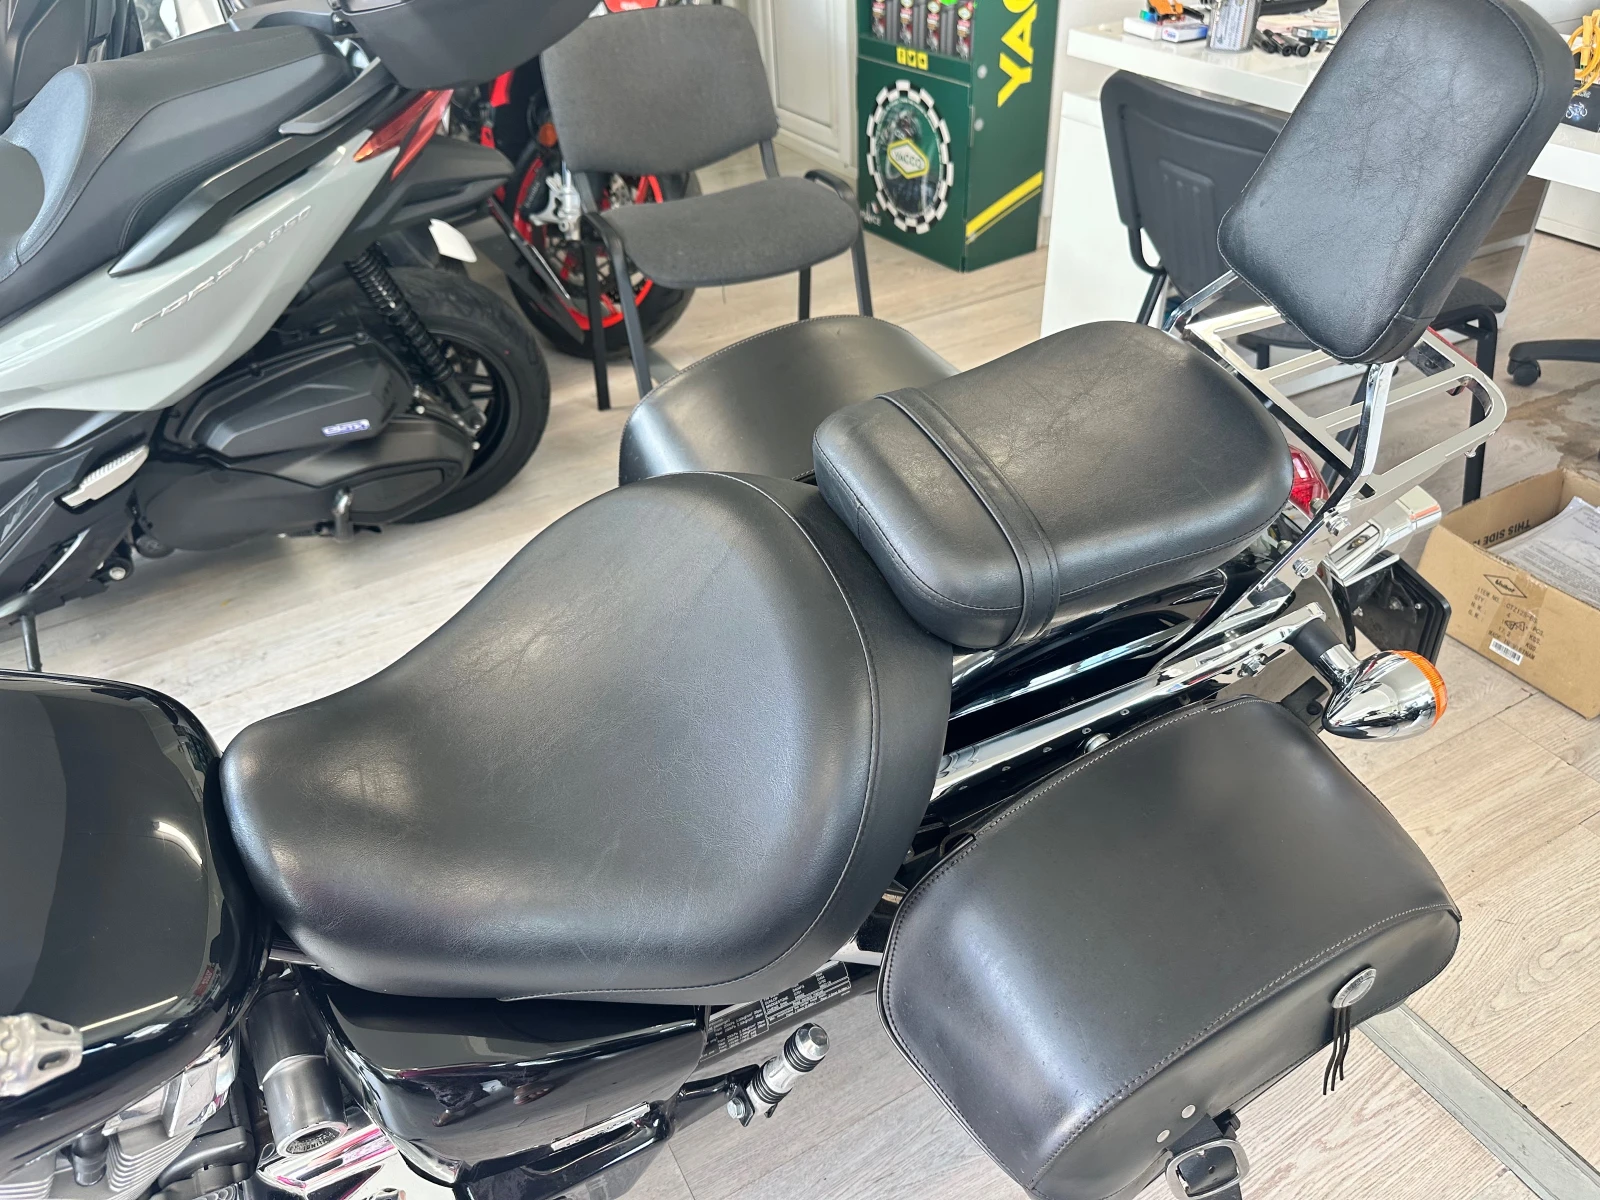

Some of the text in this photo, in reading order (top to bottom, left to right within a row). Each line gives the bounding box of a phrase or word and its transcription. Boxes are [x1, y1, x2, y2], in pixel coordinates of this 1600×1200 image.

[997, 0, 1038, 108] YA
[1483, 519, 1531, 546] THIS SIDE
